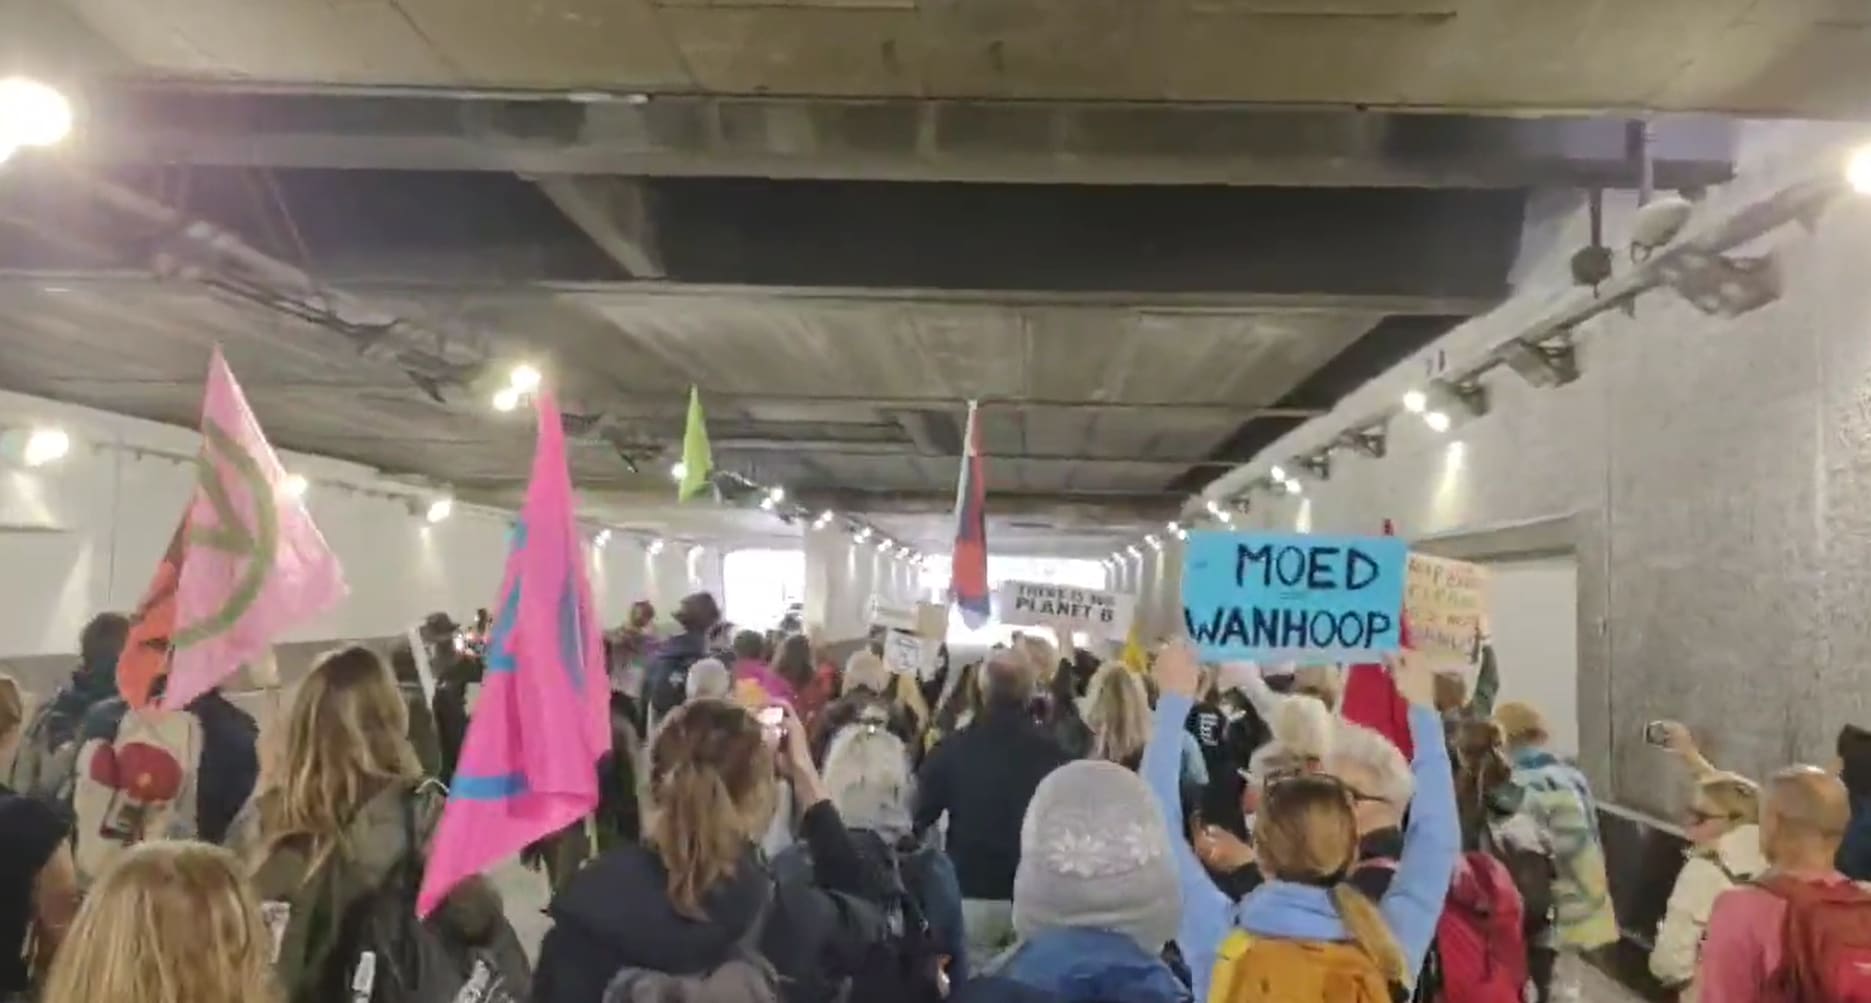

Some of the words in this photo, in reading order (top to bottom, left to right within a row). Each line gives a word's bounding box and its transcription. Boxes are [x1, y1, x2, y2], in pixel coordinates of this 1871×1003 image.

[1235, 543, 1380, 590] MOED
[1015, 596, 1092, 619] PLANET
[1018, 584, 1065, 599] THERE
[1070, 589, 1084, 602] IS
[1184, 605, 1391, 649] WANHOOP
